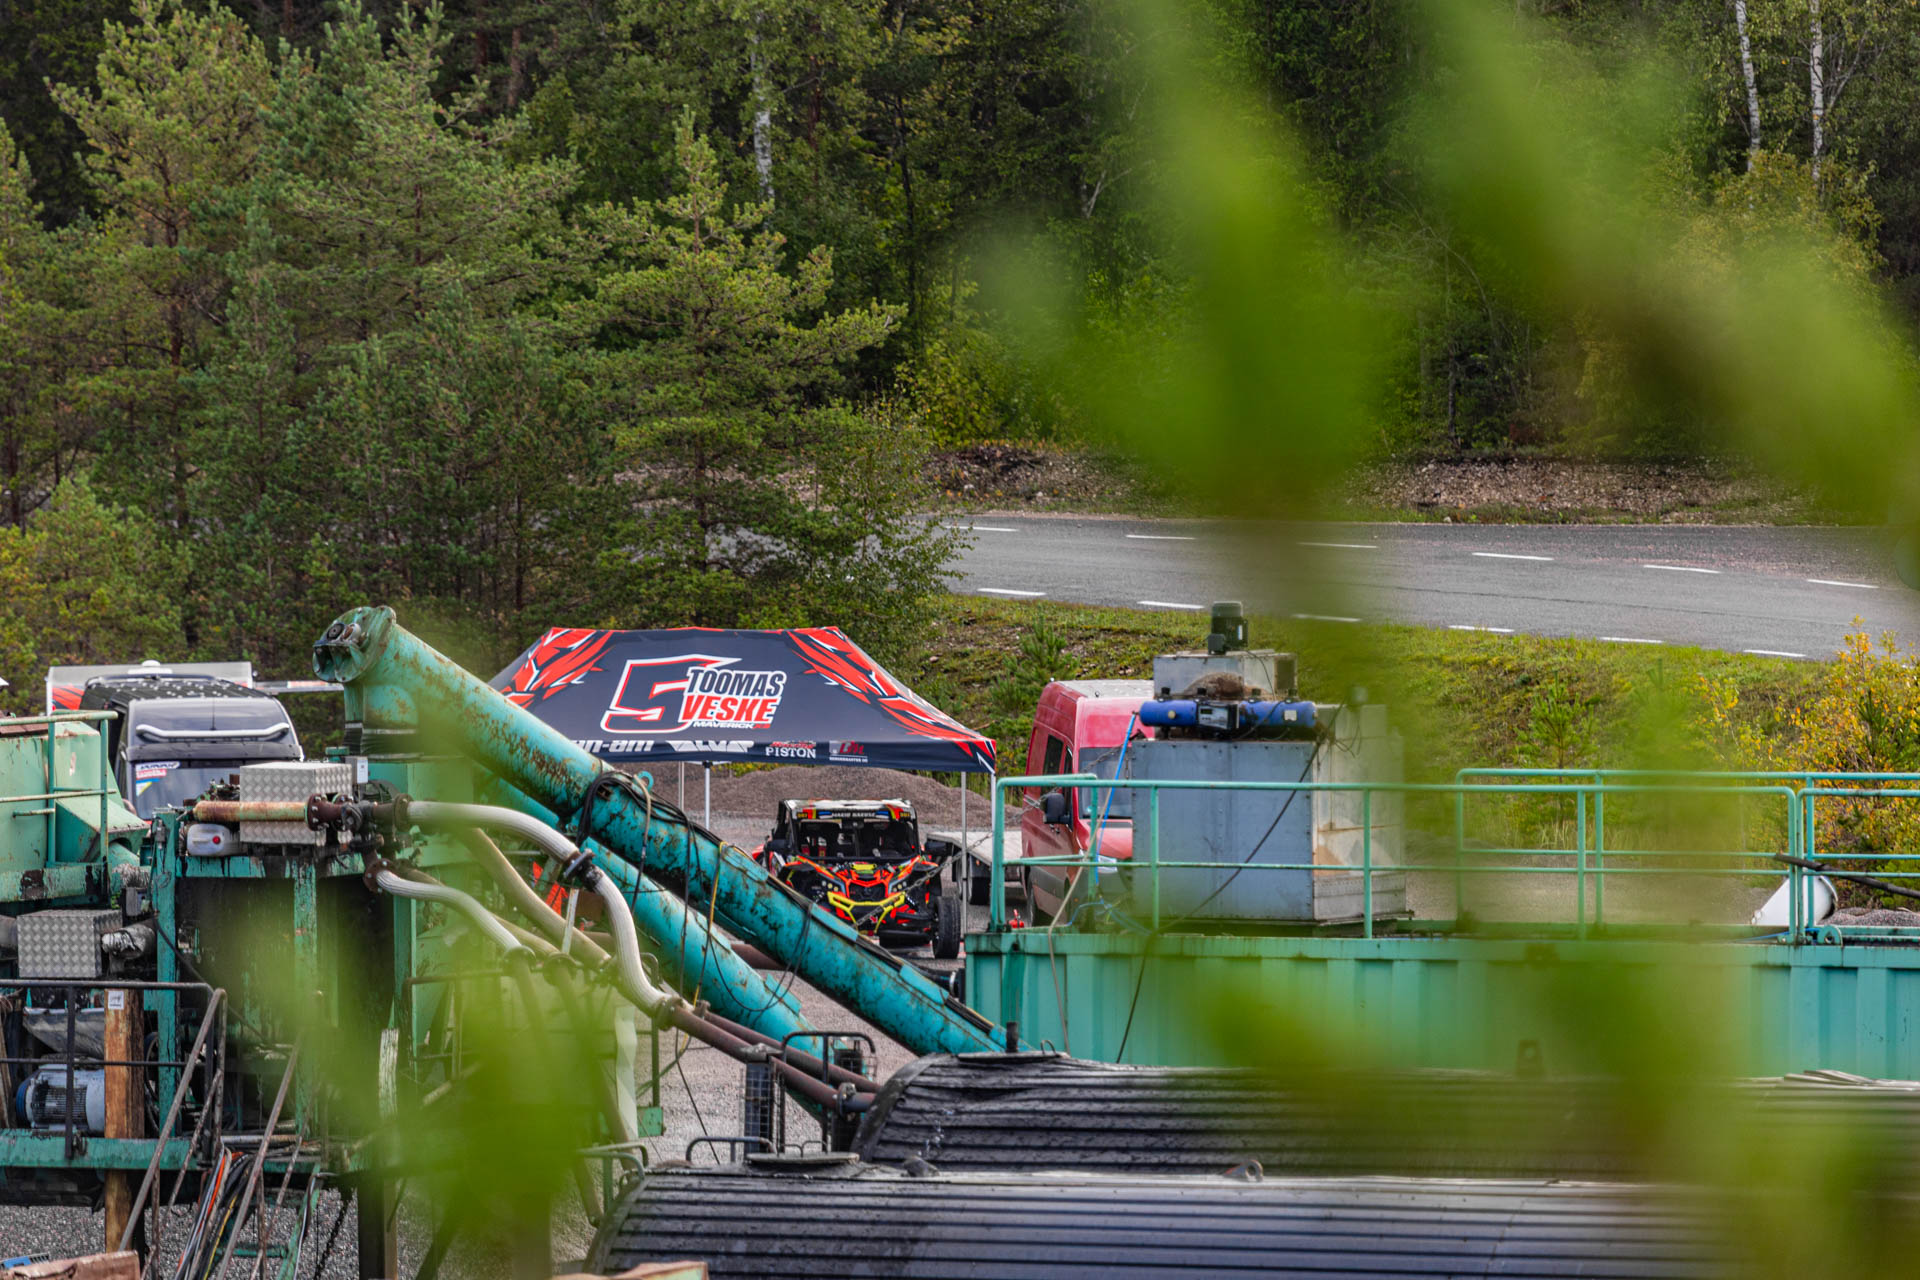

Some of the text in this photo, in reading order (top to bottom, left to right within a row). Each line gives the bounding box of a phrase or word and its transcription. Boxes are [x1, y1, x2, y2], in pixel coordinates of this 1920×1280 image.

[600, 653, 742, 733] 5
[686, 668, 786, 697] TOOMAS
[679, 694, 781, 723] VESKE
[692, 720, 754, 729] MAVERICK
[765, 746, 817, 760] PISTON
